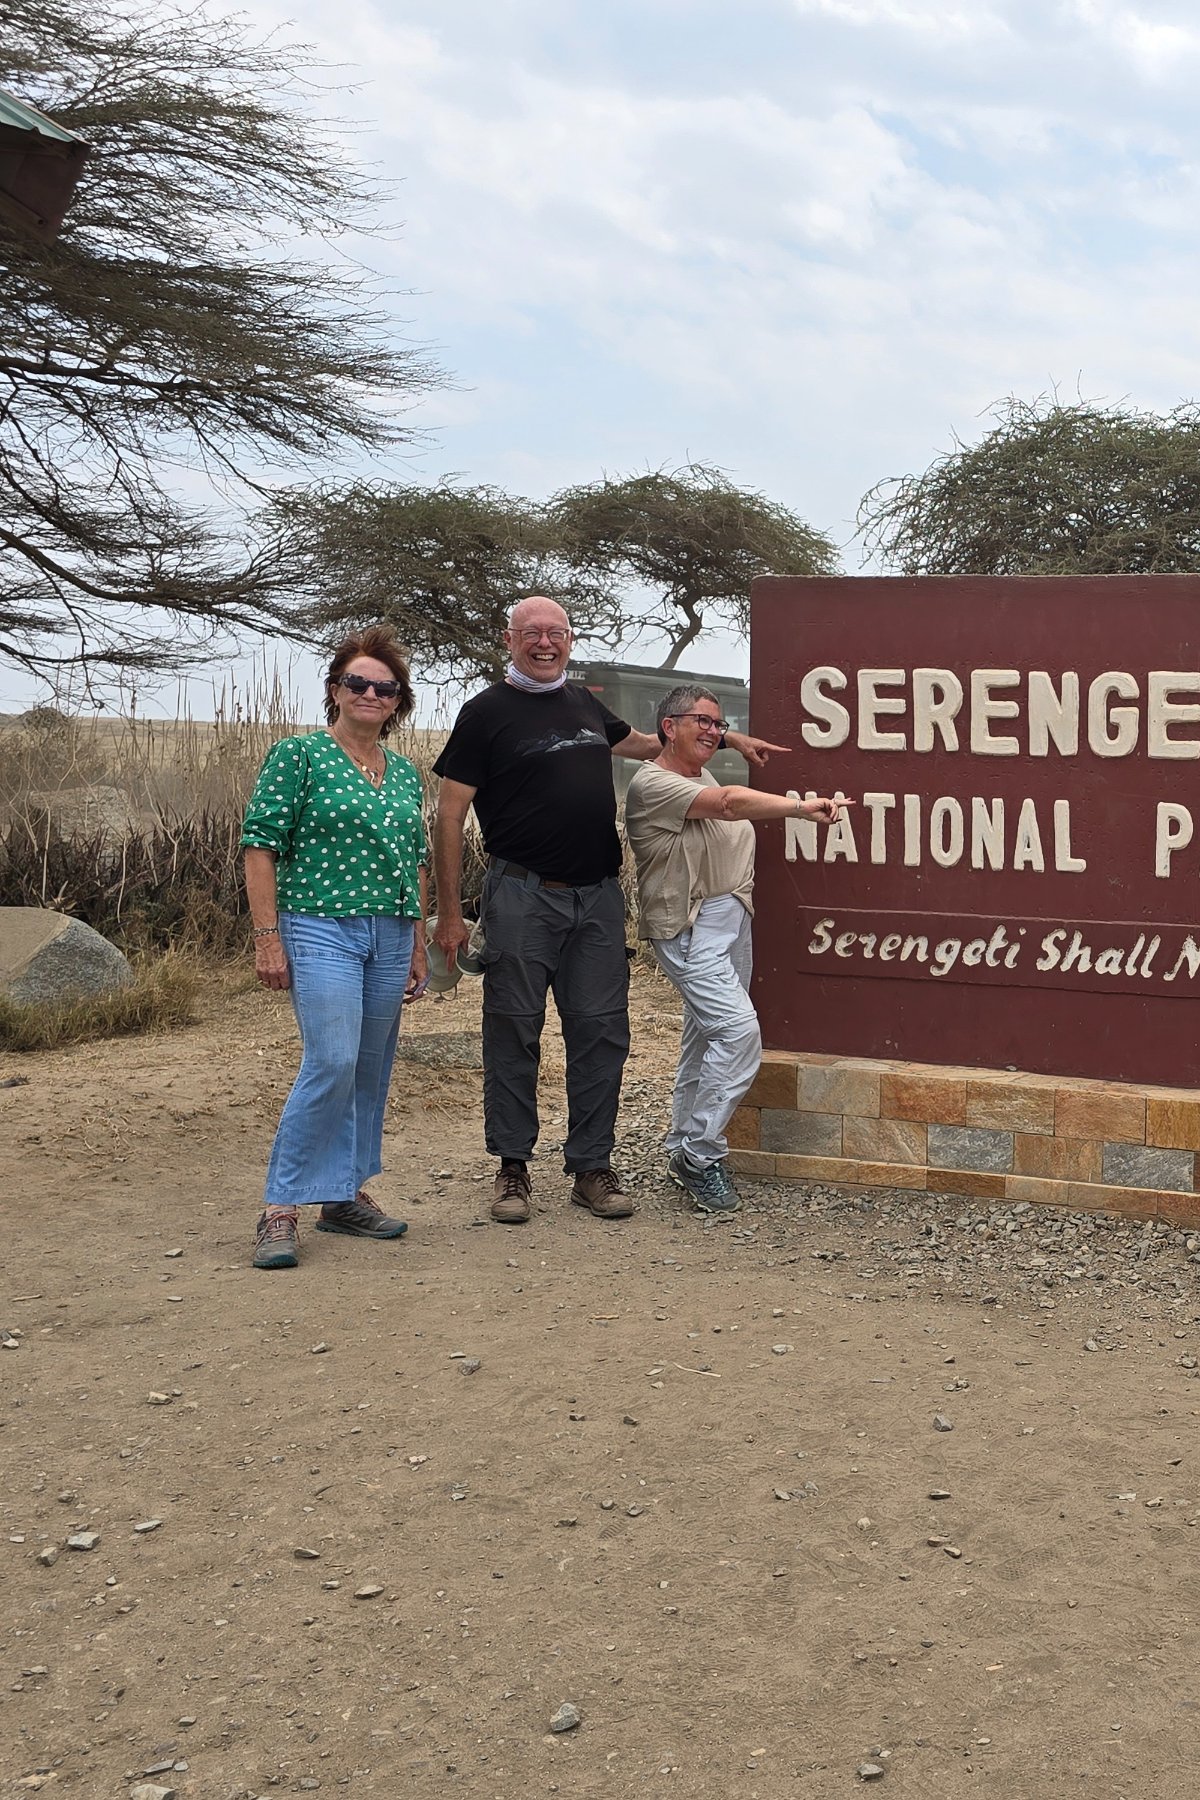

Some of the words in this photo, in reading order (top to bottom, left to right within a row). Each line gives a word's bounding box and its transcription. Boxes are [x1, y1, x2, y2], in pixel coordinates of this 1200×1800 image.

[785, 790, 1086, 873] NATIONAL
[808, 917, 1027, 976] Serengeti
[1036, 928, 1161, 980] Shall
